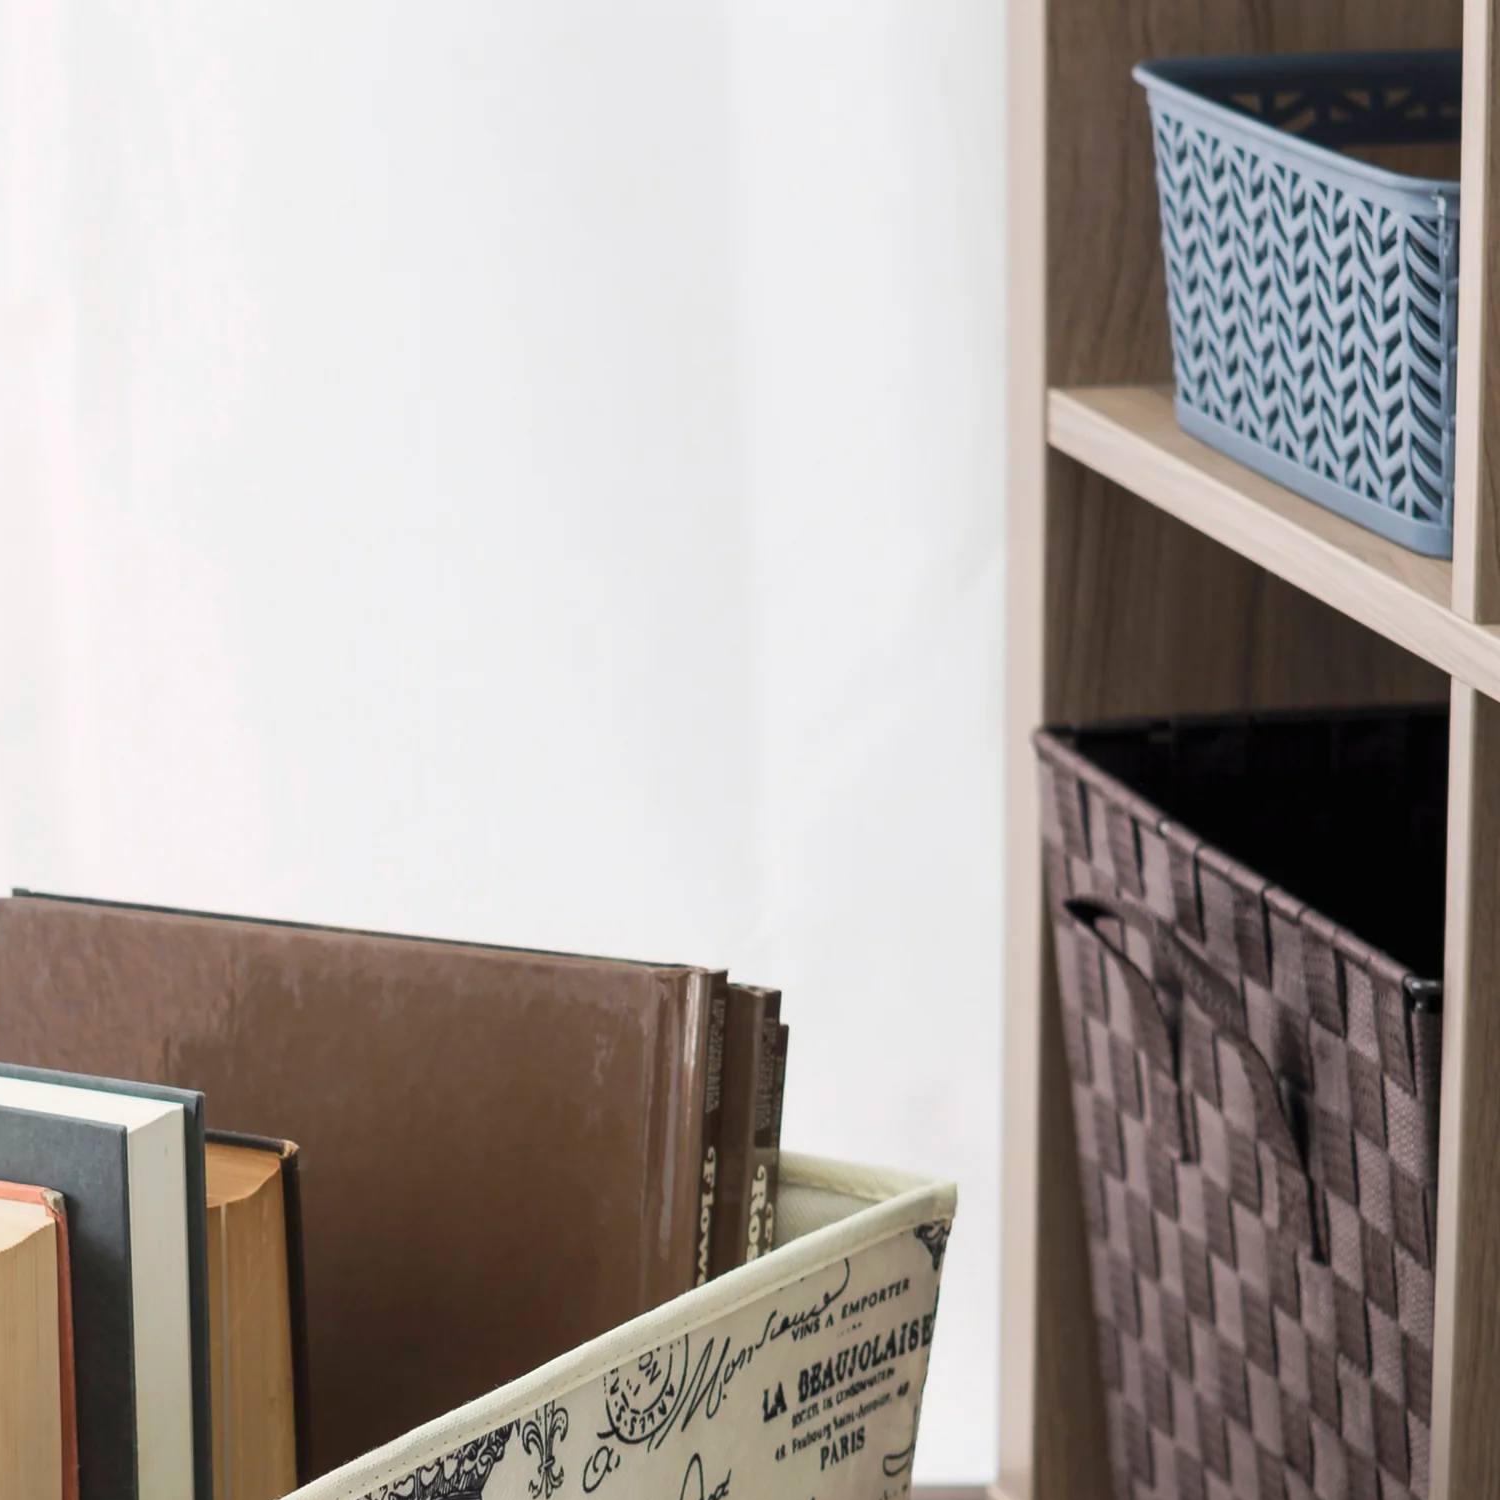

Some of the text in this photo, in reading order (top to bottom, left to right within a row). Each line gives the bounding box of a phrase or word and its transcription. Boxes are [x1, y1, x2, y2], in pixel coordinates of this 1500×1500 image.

[792, 1317, 820, 1341] VINS
[841, 1278, 910, 1320] EMPORTER
[763, 1312, 934, 1423] LA BEAUJOLAISE
[820, 1426, 865, 1481] PARIS
